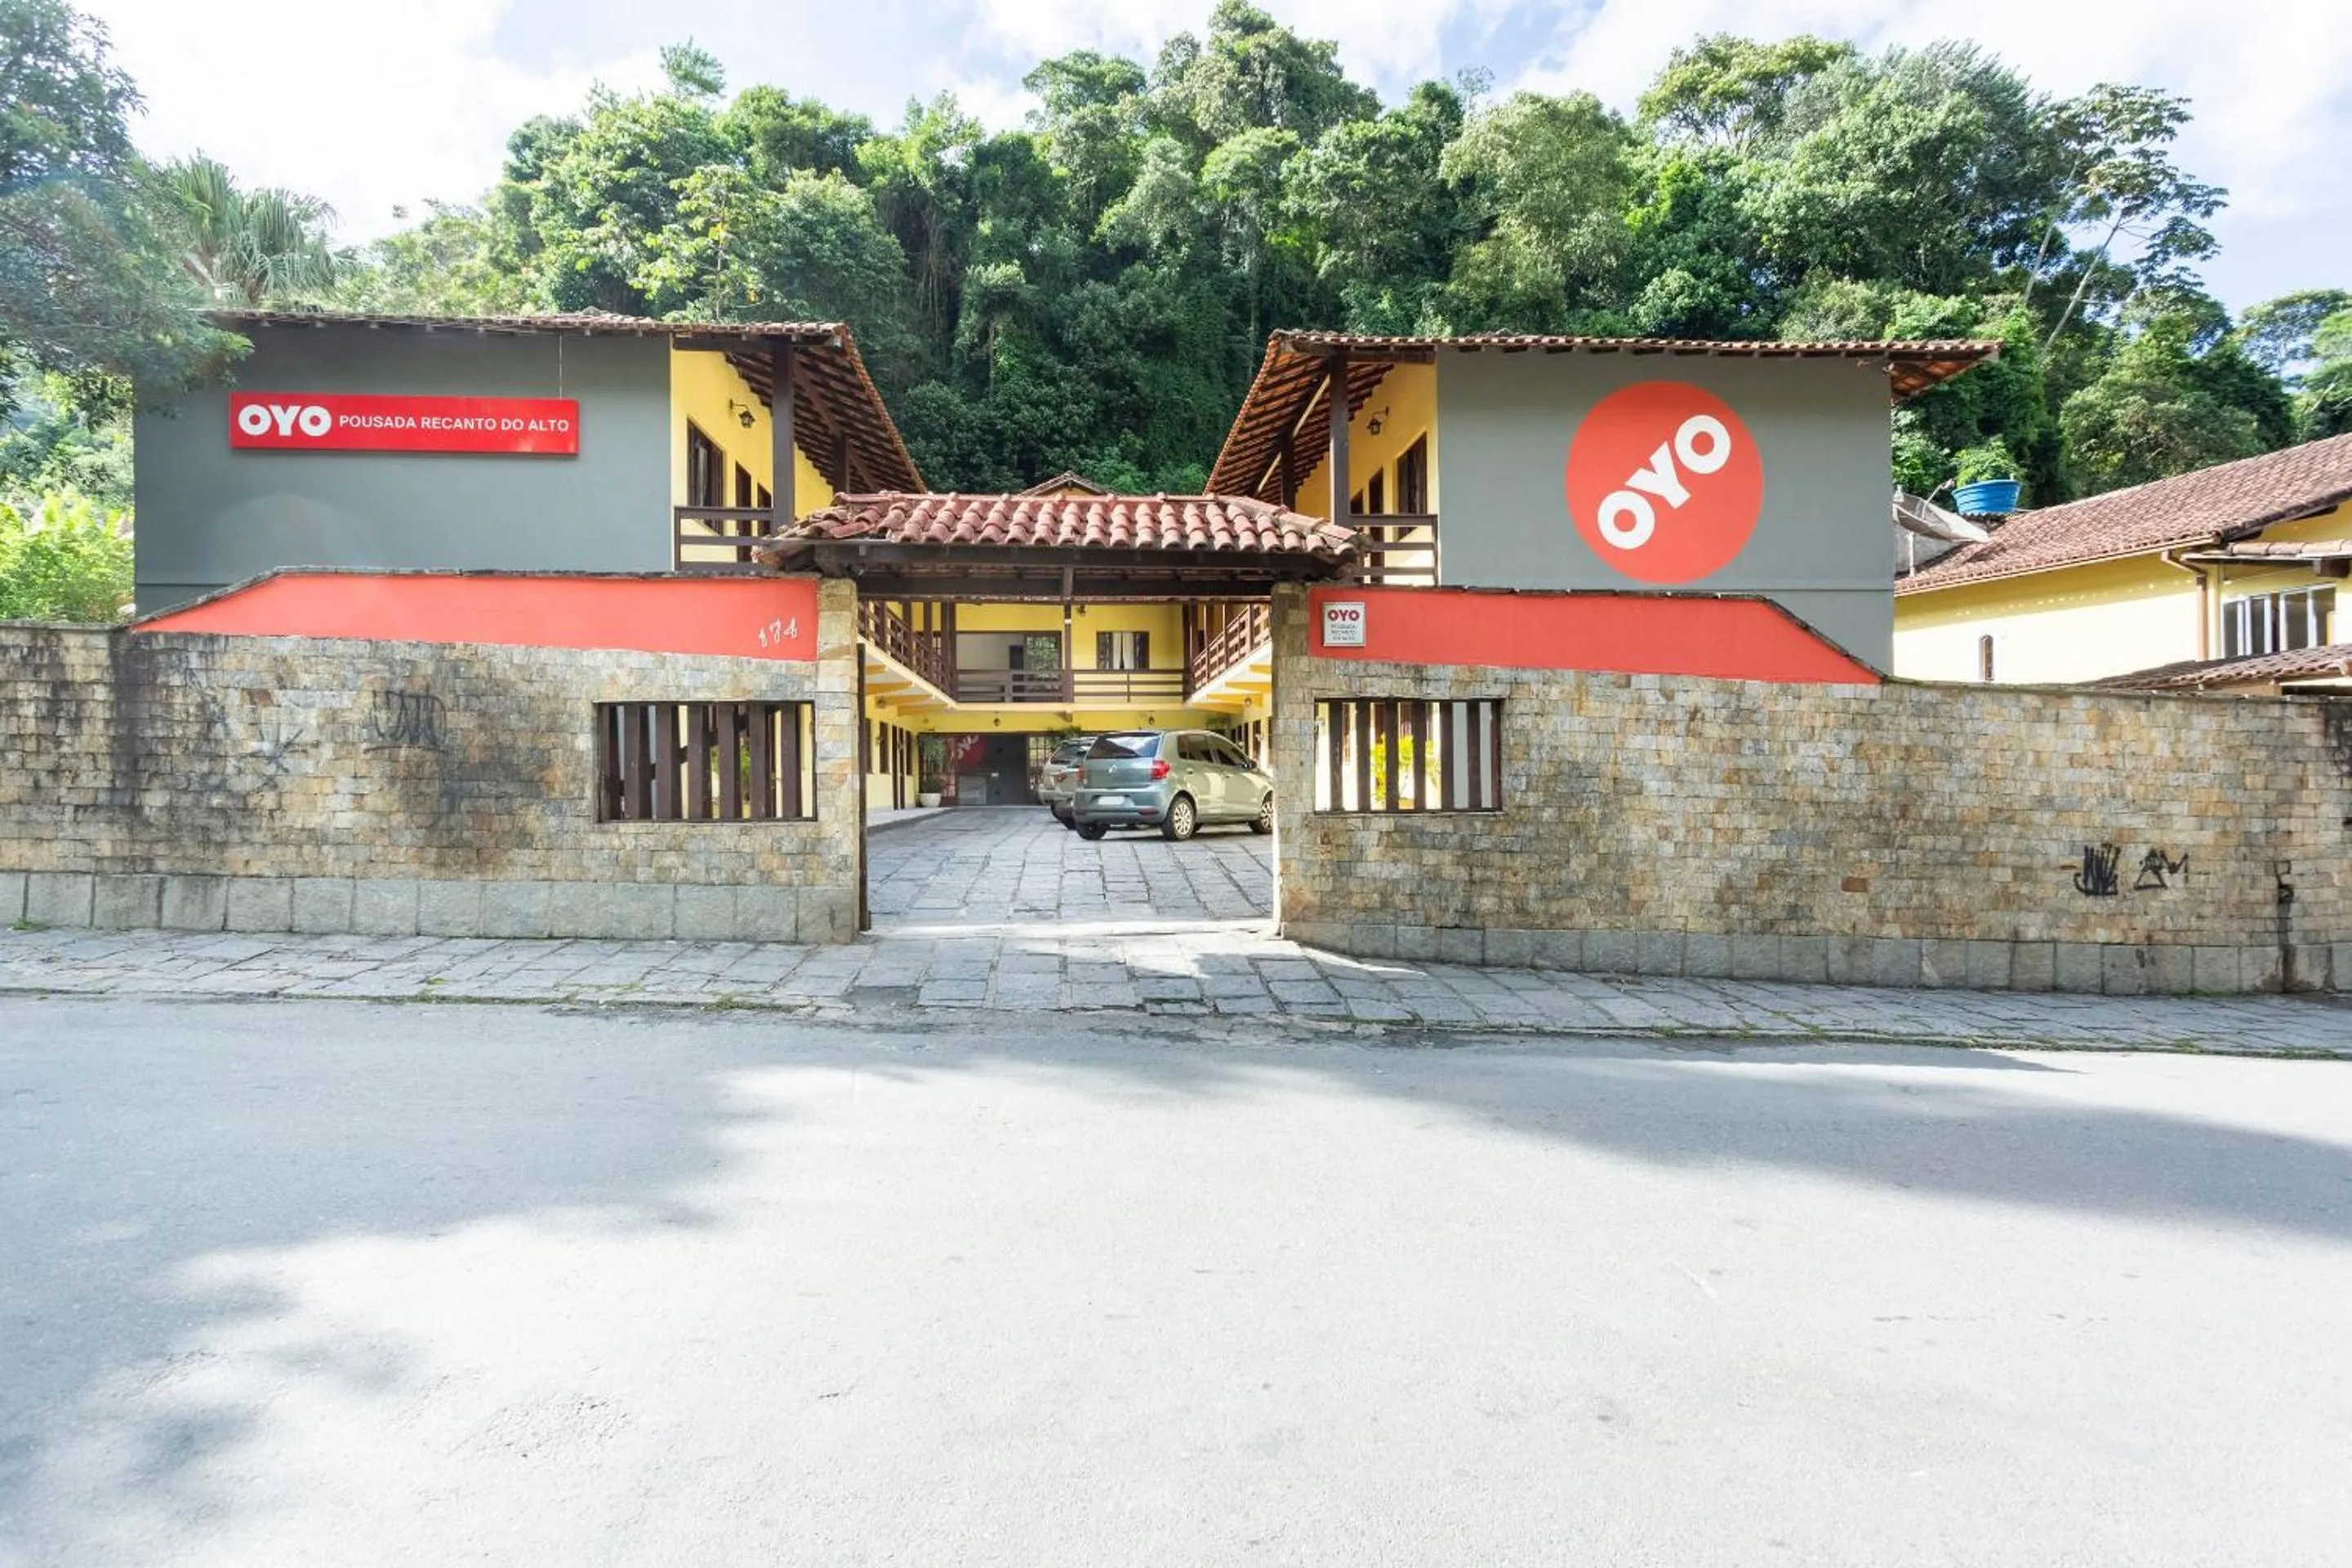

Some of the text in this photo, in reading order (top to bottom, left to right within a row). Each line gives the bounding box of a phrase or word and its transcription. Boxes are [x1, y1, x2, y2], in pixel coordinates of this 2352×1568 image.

[238, 404, 569, 436] OYO POUSADA RECANTO DO ALTO
[1597, 415, 1731, 550] OYO
[1328, 609, 1360, 621] OYO
